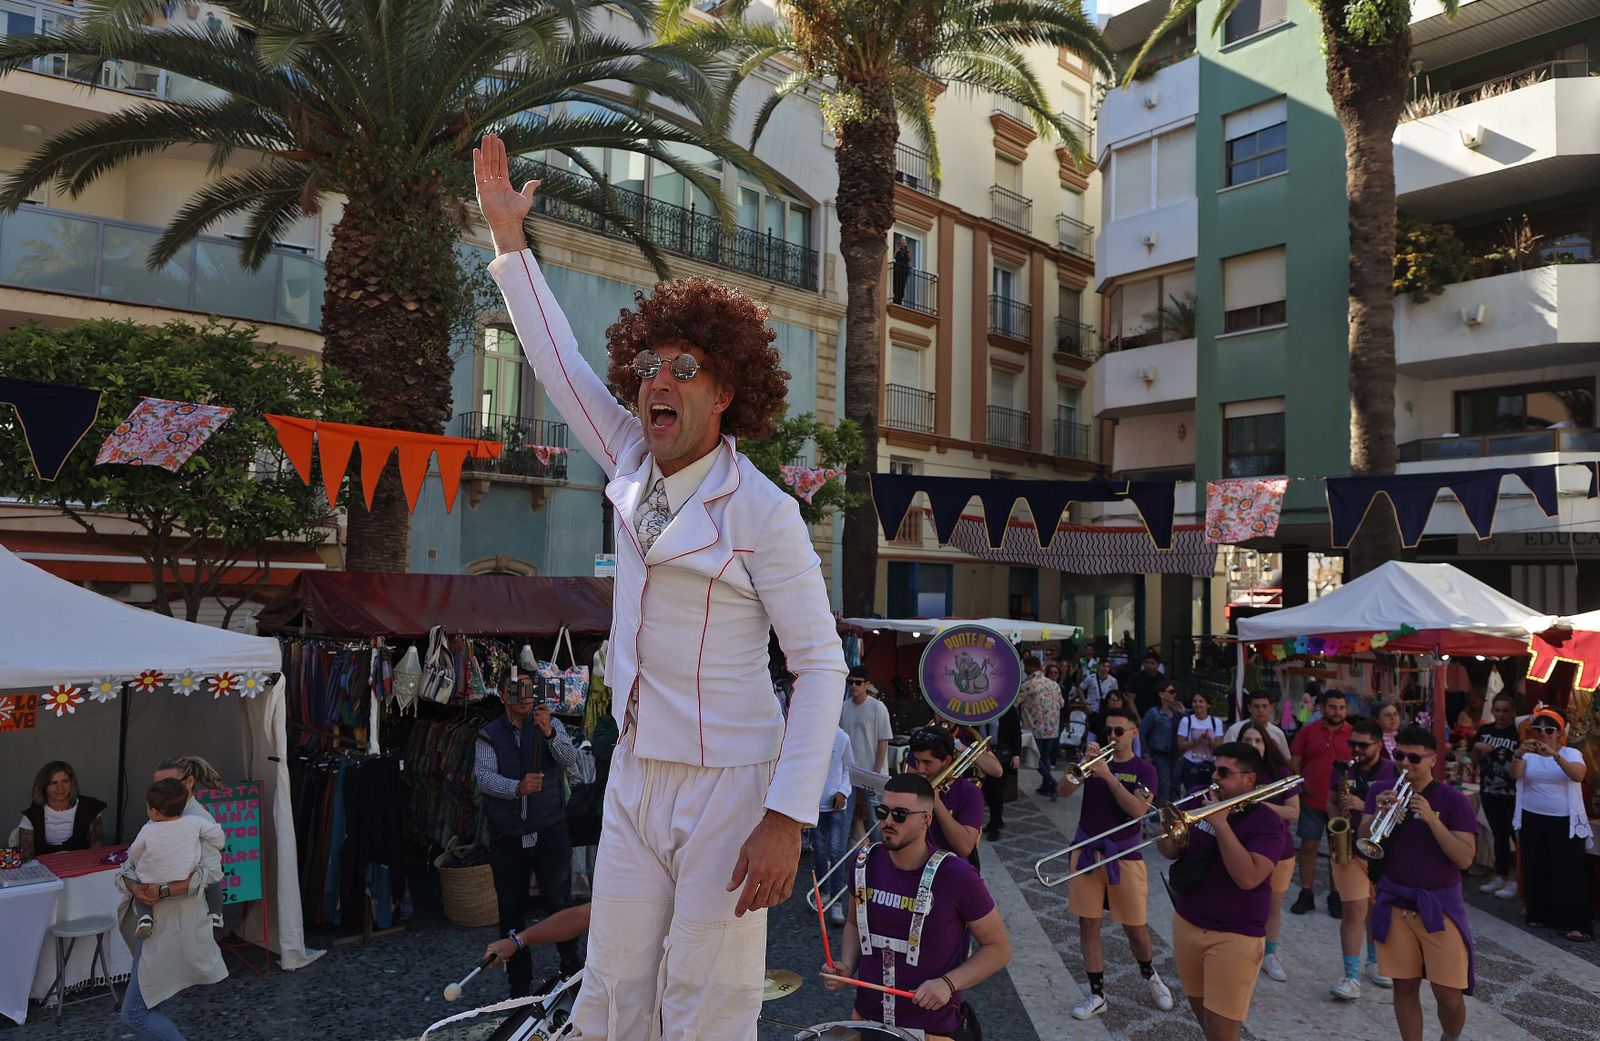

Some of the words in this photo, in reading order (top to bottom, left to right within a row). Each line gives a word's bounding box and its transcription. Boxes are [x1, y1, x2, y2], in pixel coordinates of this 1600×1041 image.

[944, 632, 977, 651] PONTE
[16, 694, 37, 710] LO
[196, 785, 259, 800] FERTA
[202, 799, 259, 813] ATTOO
[215, 811, 255, 823] NNA
[224, 826, 258, 839] TOO
[866, 887, 915, 912] #TOURPU
